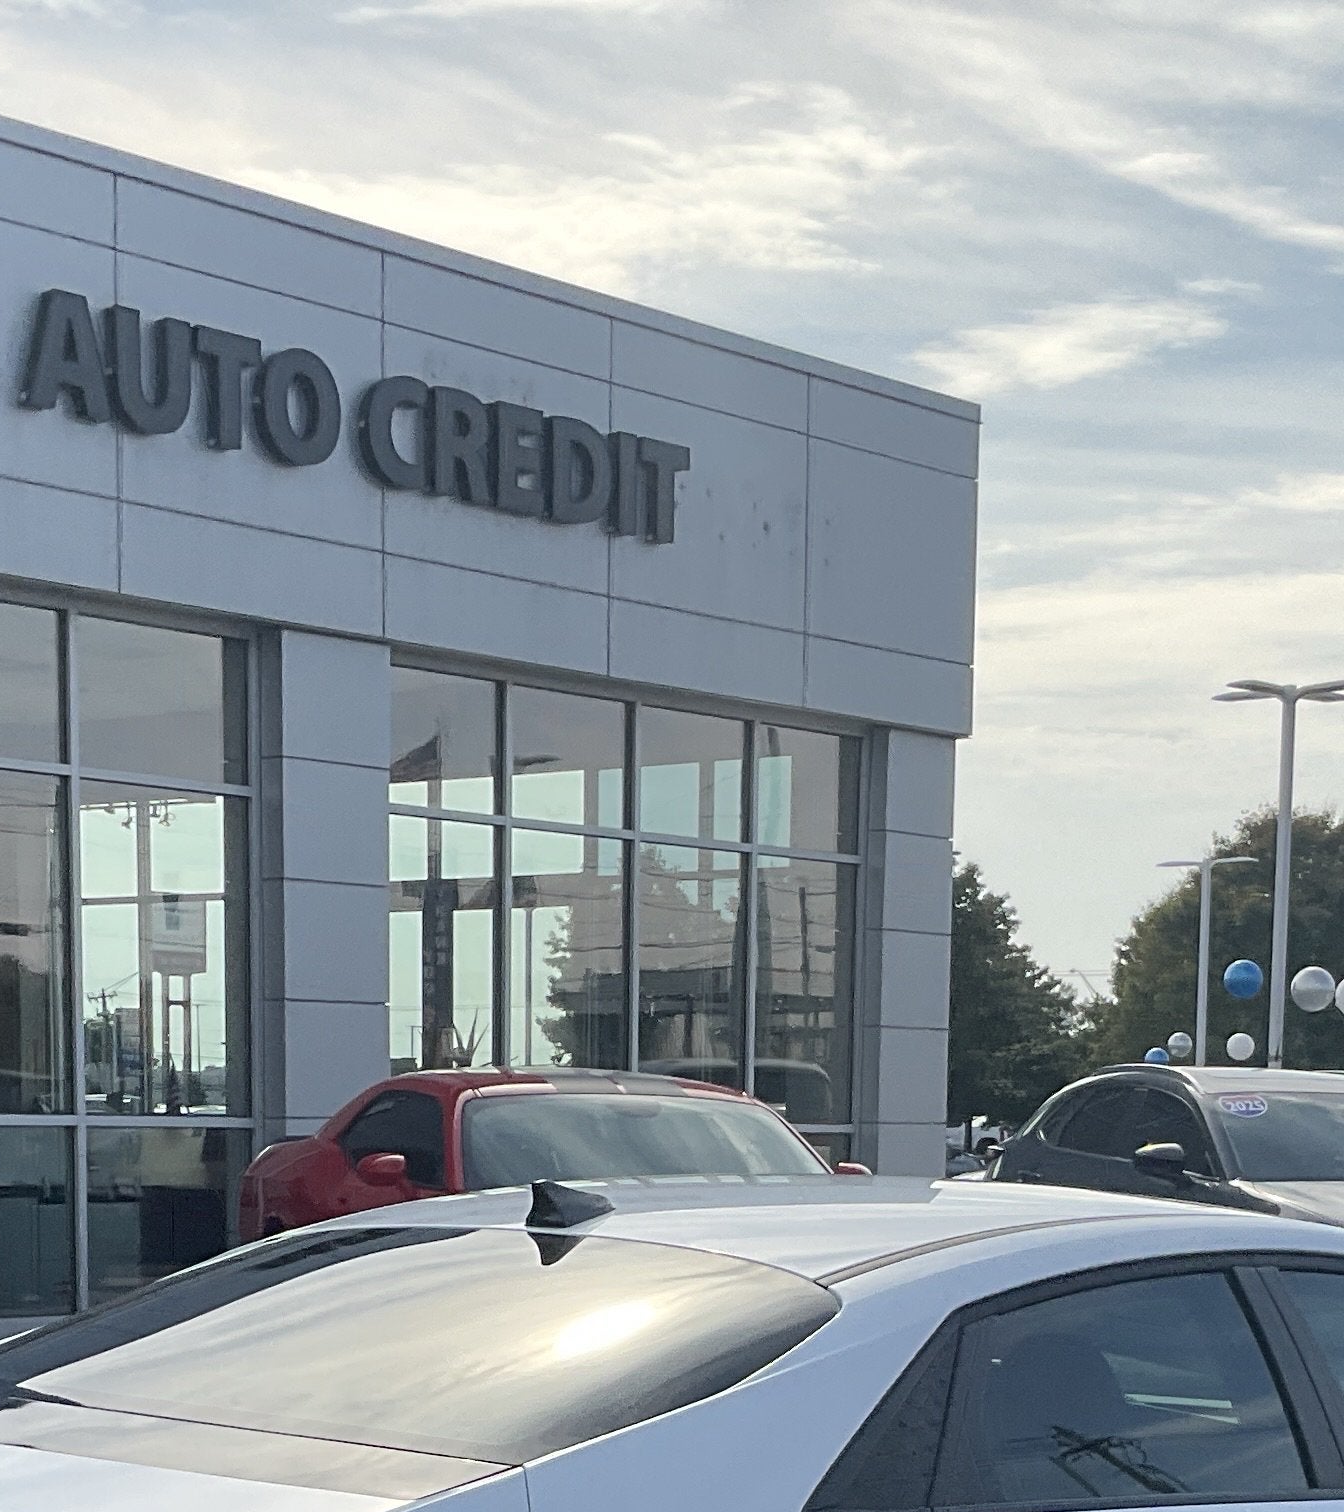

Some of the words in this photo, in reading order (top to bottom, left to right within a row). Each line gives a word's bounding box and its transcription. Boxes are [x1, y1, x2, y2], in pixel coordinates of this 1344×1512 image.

[16, 288, 341, 467] AUTO
[356, 375, 690, 545] CREDIT
[1225, 1100, 1265, 1111] 2025
